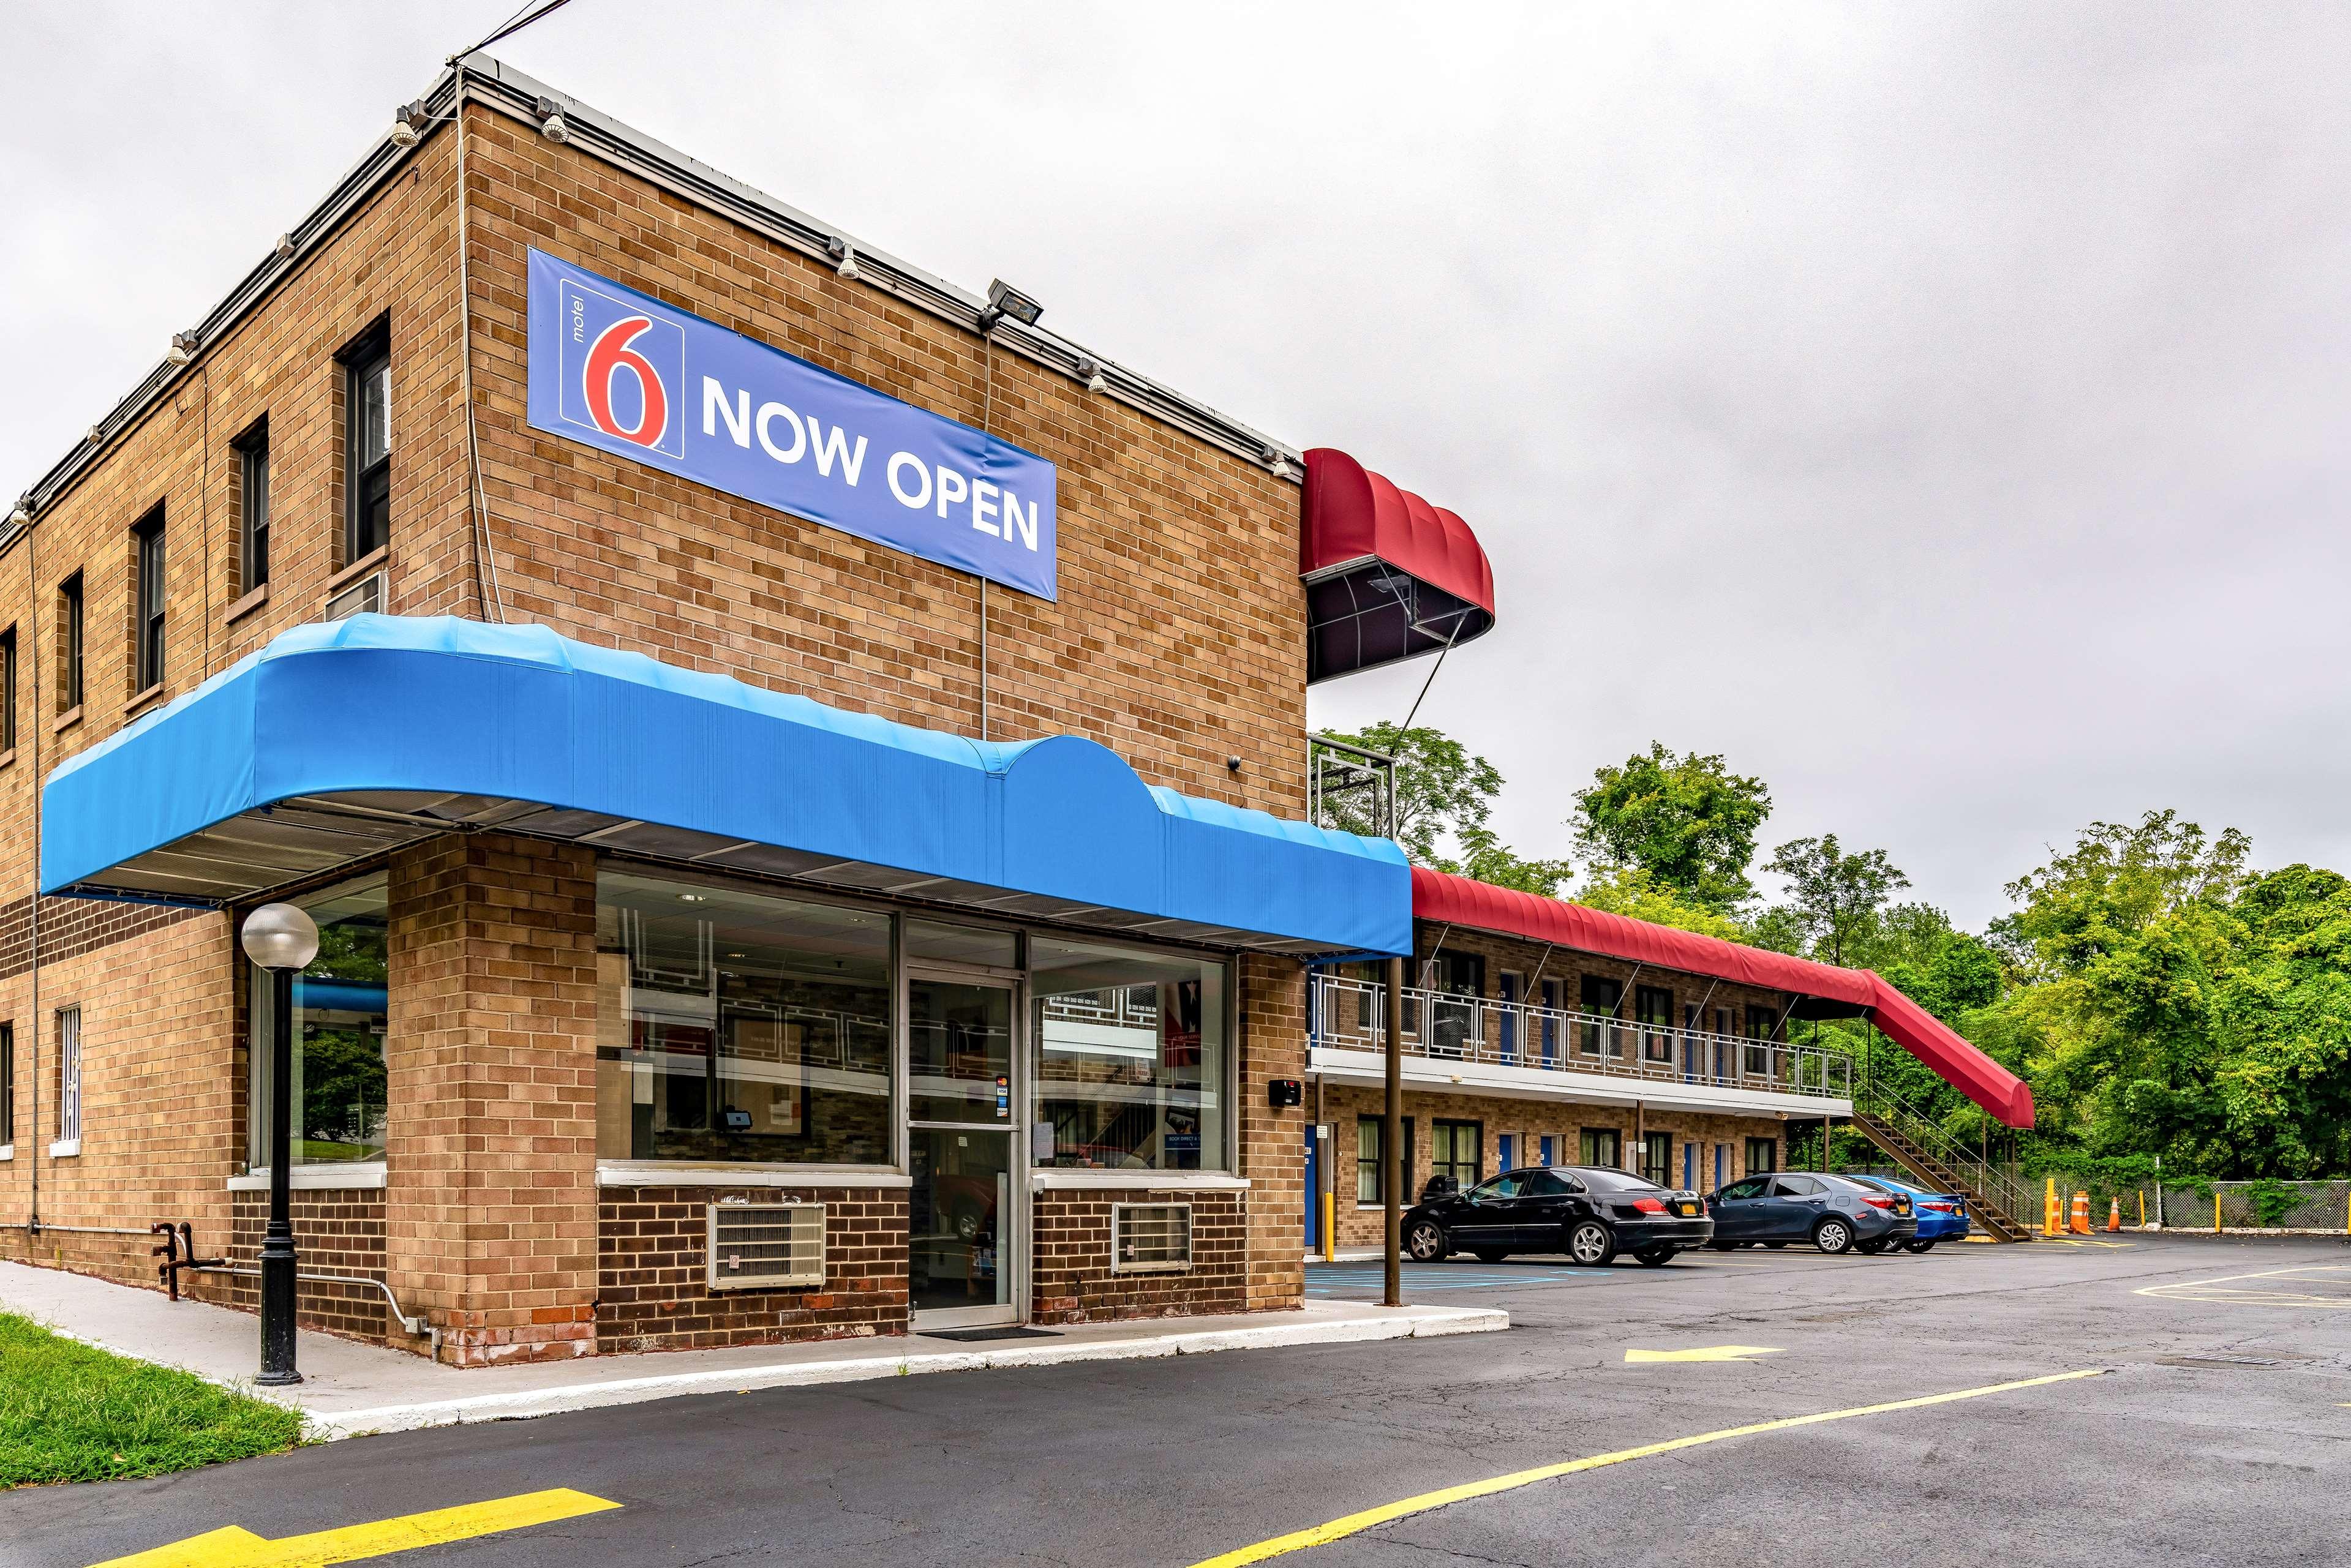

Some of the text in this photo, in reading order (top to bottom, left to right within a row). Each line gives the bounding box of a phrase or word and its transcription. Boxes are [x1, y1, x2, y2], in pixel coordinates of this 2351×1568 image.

[571, 294, 584, 343] motel
[582, 315, 669, 449] 6
[703, 375, 1038, 552] NOW OPEN
